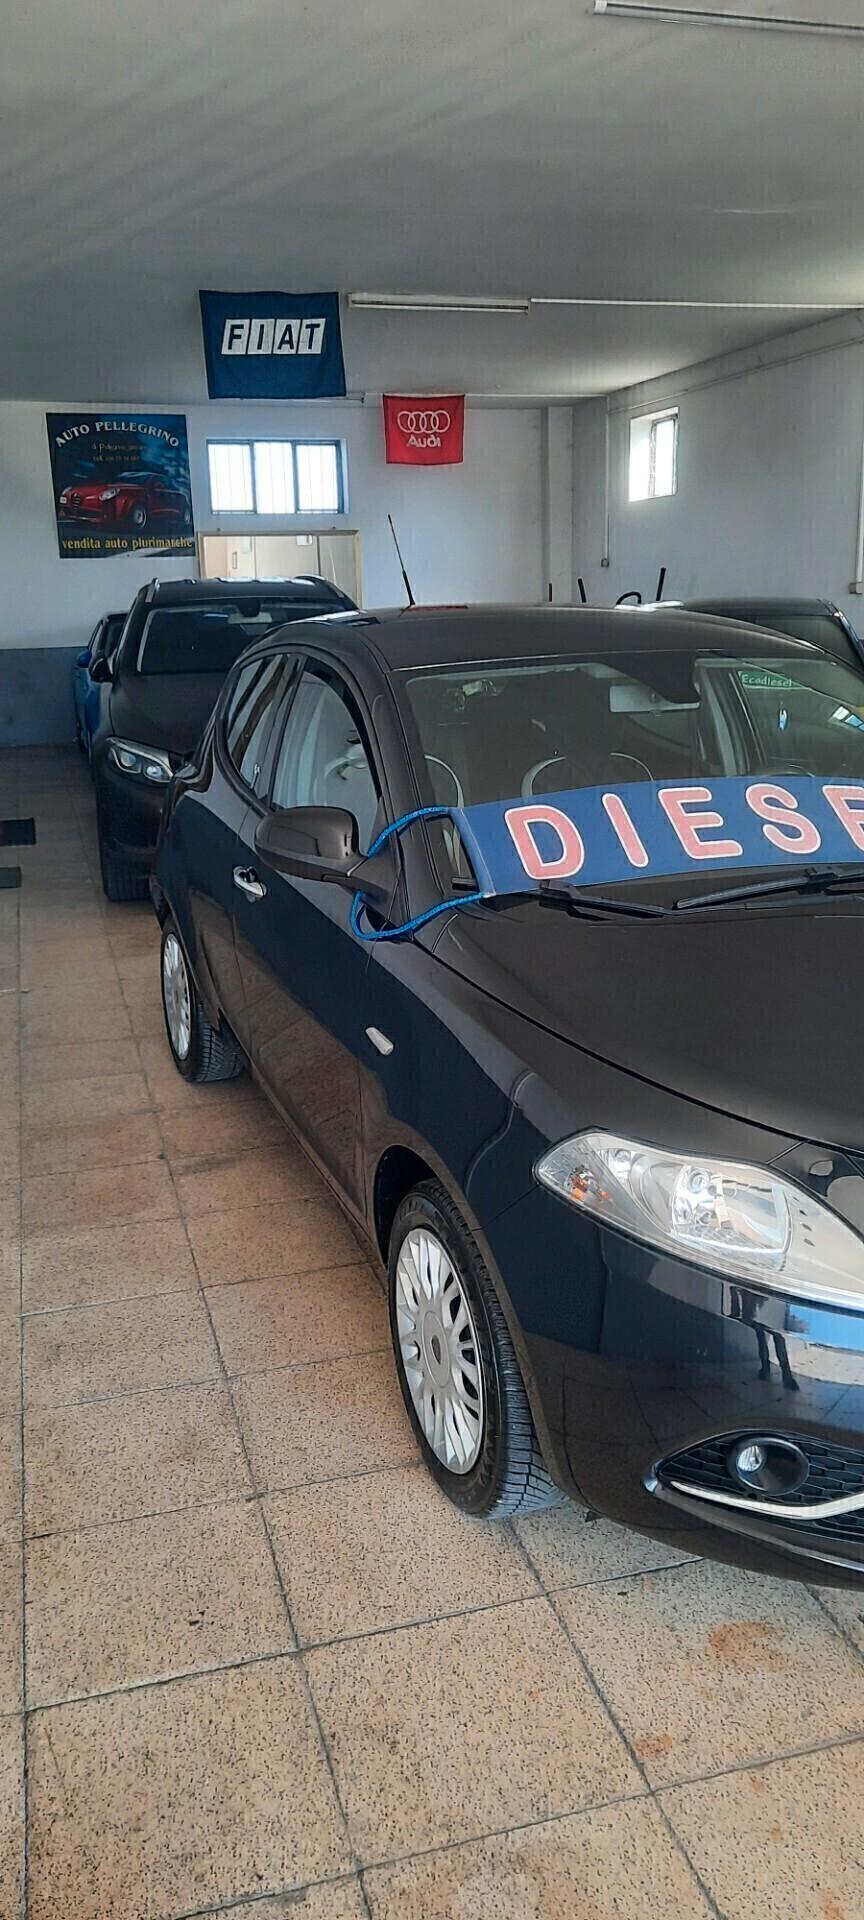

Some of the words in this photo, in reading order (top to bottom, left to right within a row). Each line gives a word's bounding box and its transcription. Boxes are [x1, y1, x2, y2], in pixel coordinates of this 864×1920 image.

[226, 324, 321, 351] FIAT
[55, 424, 90, 447] AUTO
[96, 422, 179, 446] PELLEGRINO
[406, 434, 442, 448] Audi
[62, 537, 101, 549] vendita
[105, 537, 128, 549] auto
[742, 674, 792, 688] Ecodiesel
